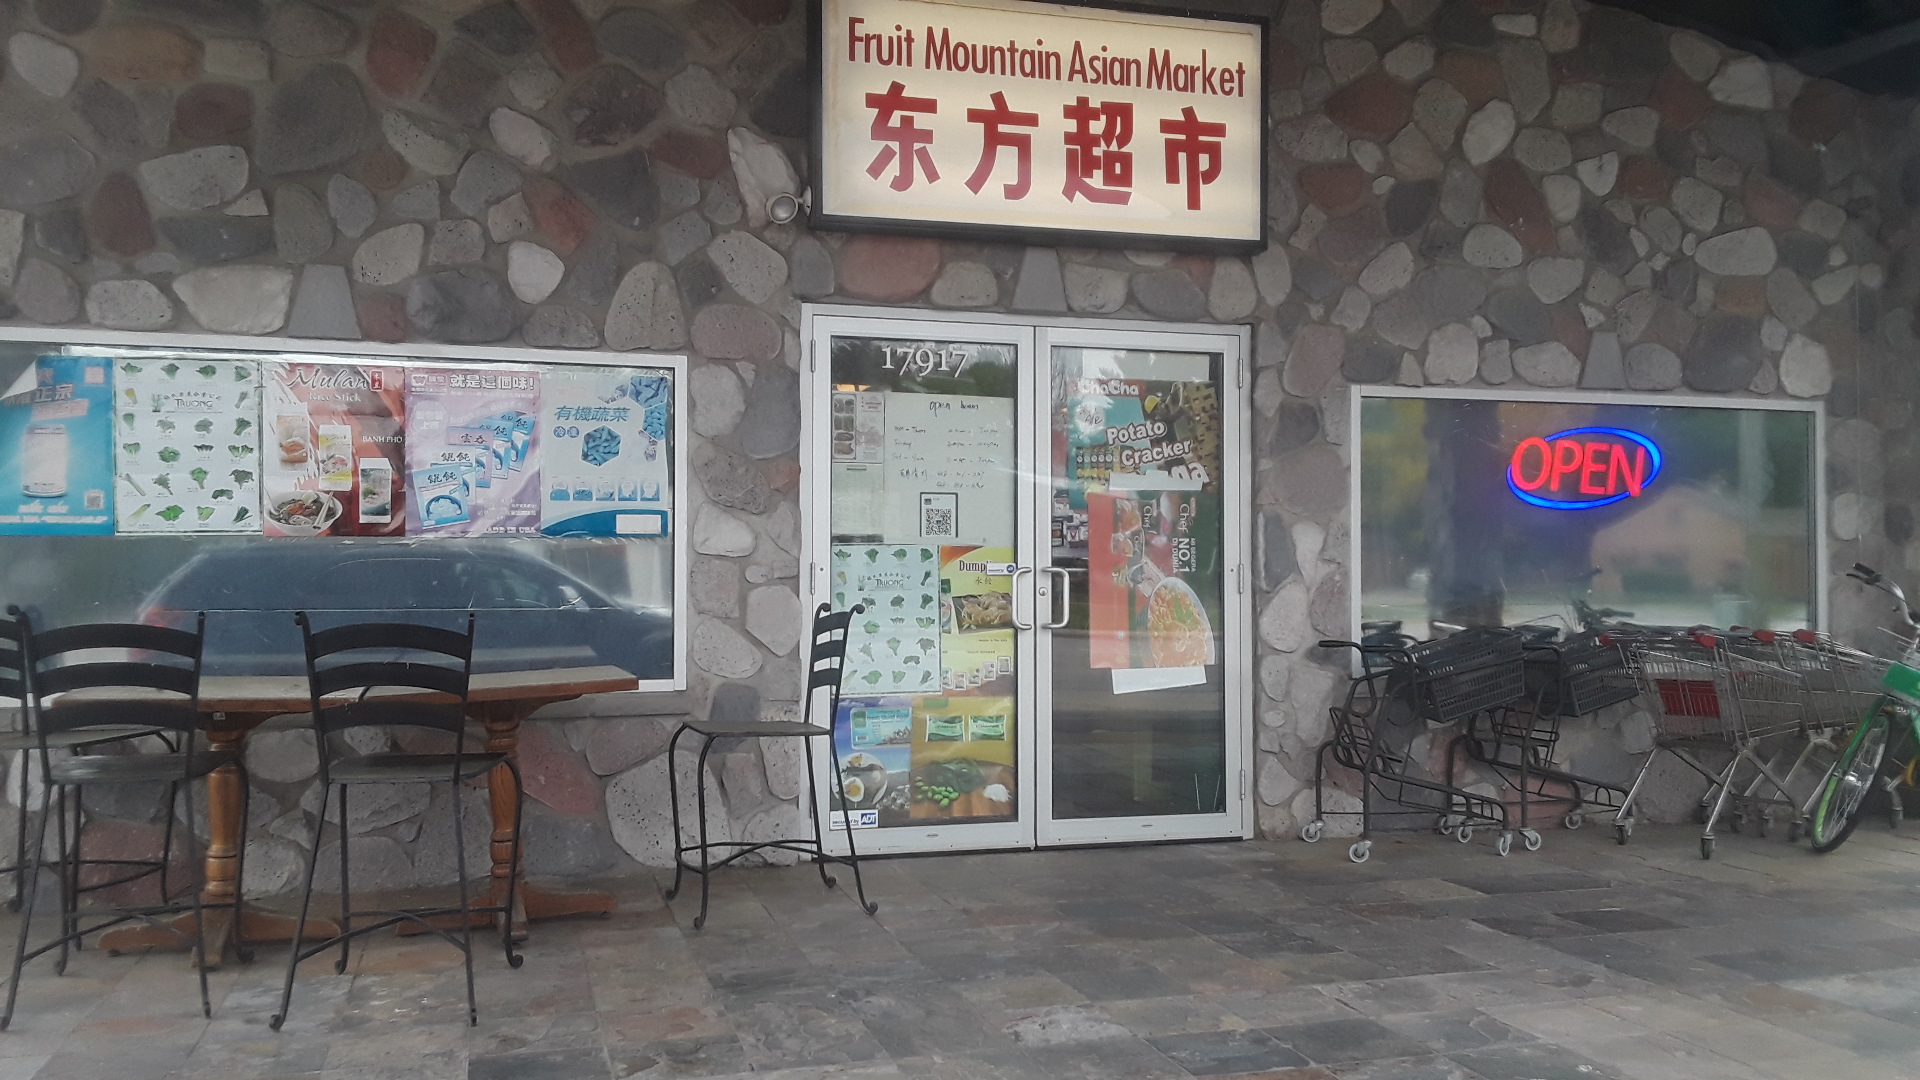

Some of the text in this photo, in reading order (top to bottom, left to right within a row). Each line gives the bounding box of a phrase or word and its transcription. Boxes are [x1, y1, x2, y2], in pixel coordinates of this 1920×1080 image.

[848, 16, 1246, 98] Fruit Mountain Asian Market
[865, 80, 1227, 211] 东方超市
[881, 347, 969, 378] 17917
[286, 367, 367, 389] Mulan
[1077, 378, 1140, 396] ChaCha
[554, 405, 631, 422] 有機蔬菜
[386, 436, 403, 444] PHO
[1106, 421, 1168, 446] Potato
[1120, 440, 1192, 467] Cracker
[1510, 436, 1646, 498] OPEN
[1179, 503, 1190, 534] Chef
[1178, 538, 1190, 573] NO.1
[861, 814, 877, 824] ADT
